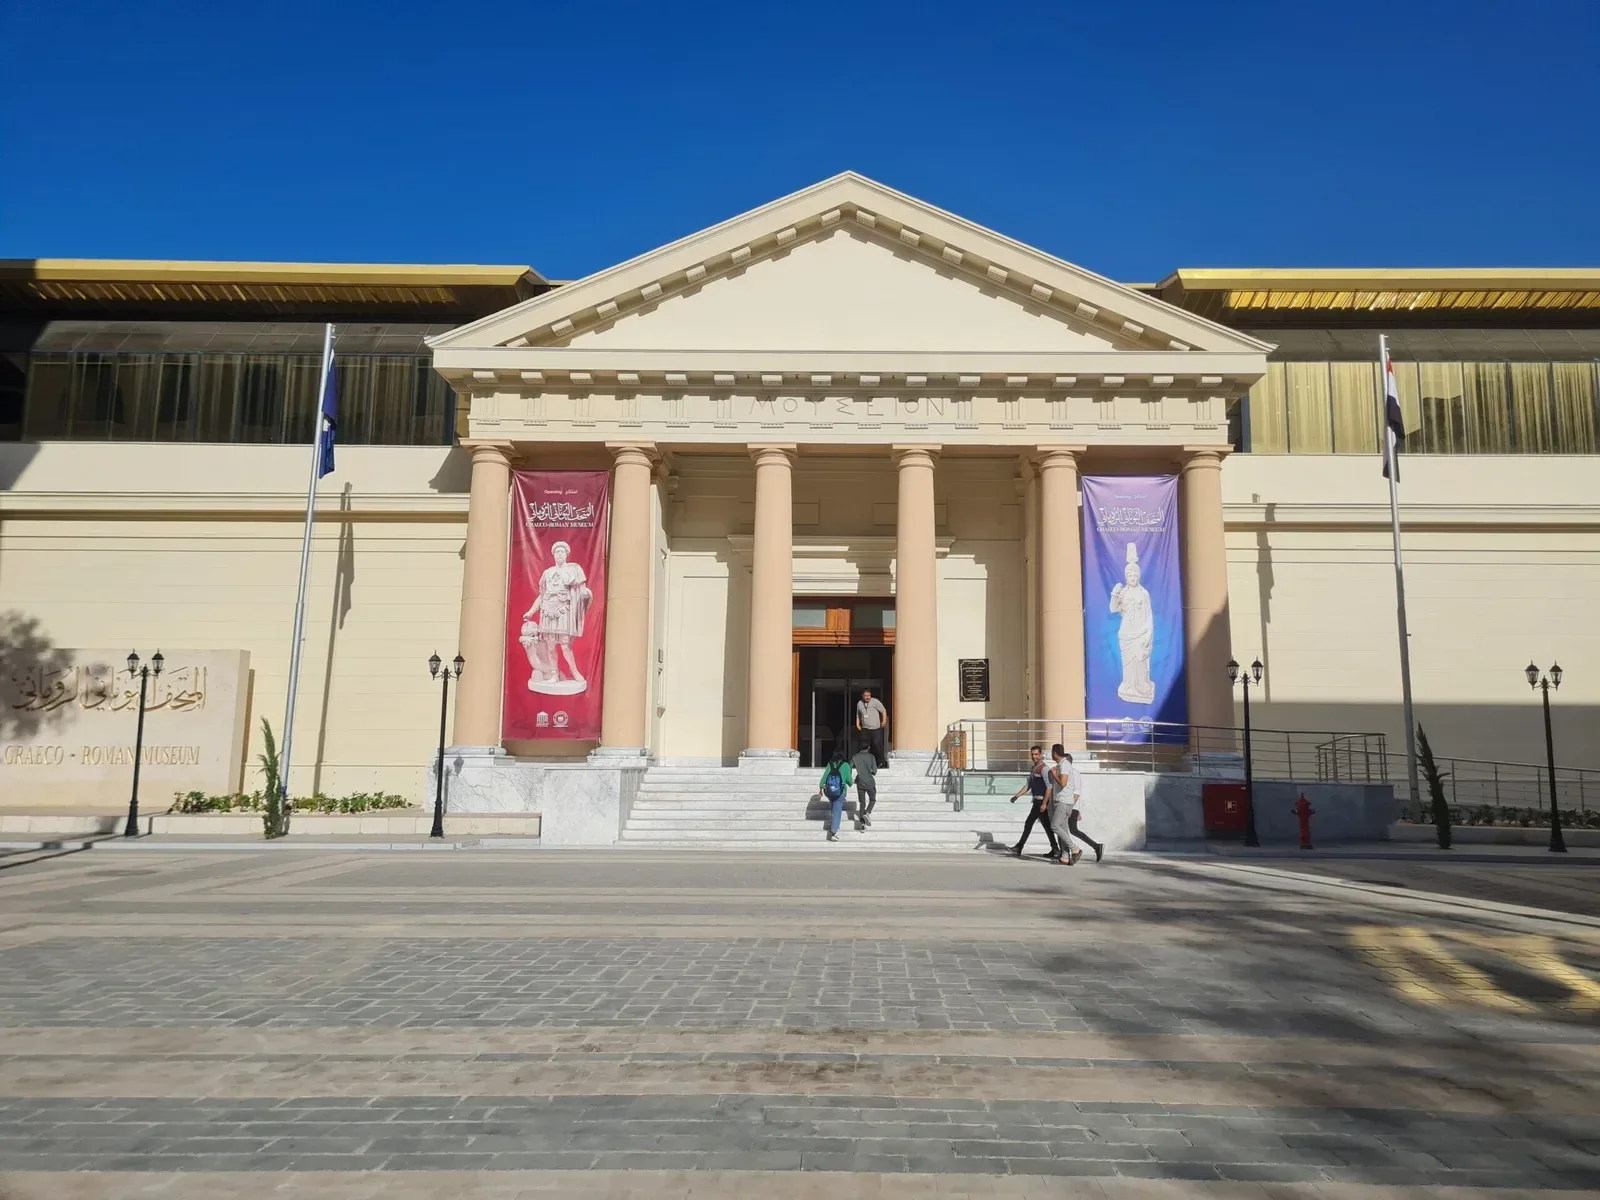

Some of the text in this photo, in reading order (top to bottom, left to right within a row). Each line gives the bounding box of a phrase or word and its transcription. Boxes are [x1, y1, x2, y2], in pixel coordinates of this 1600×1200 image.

[4, 745, 65, 765] GRAECO
[80, 745, 137, 765] ROMAN
[140, 745, 200, 765] MUSEUM
